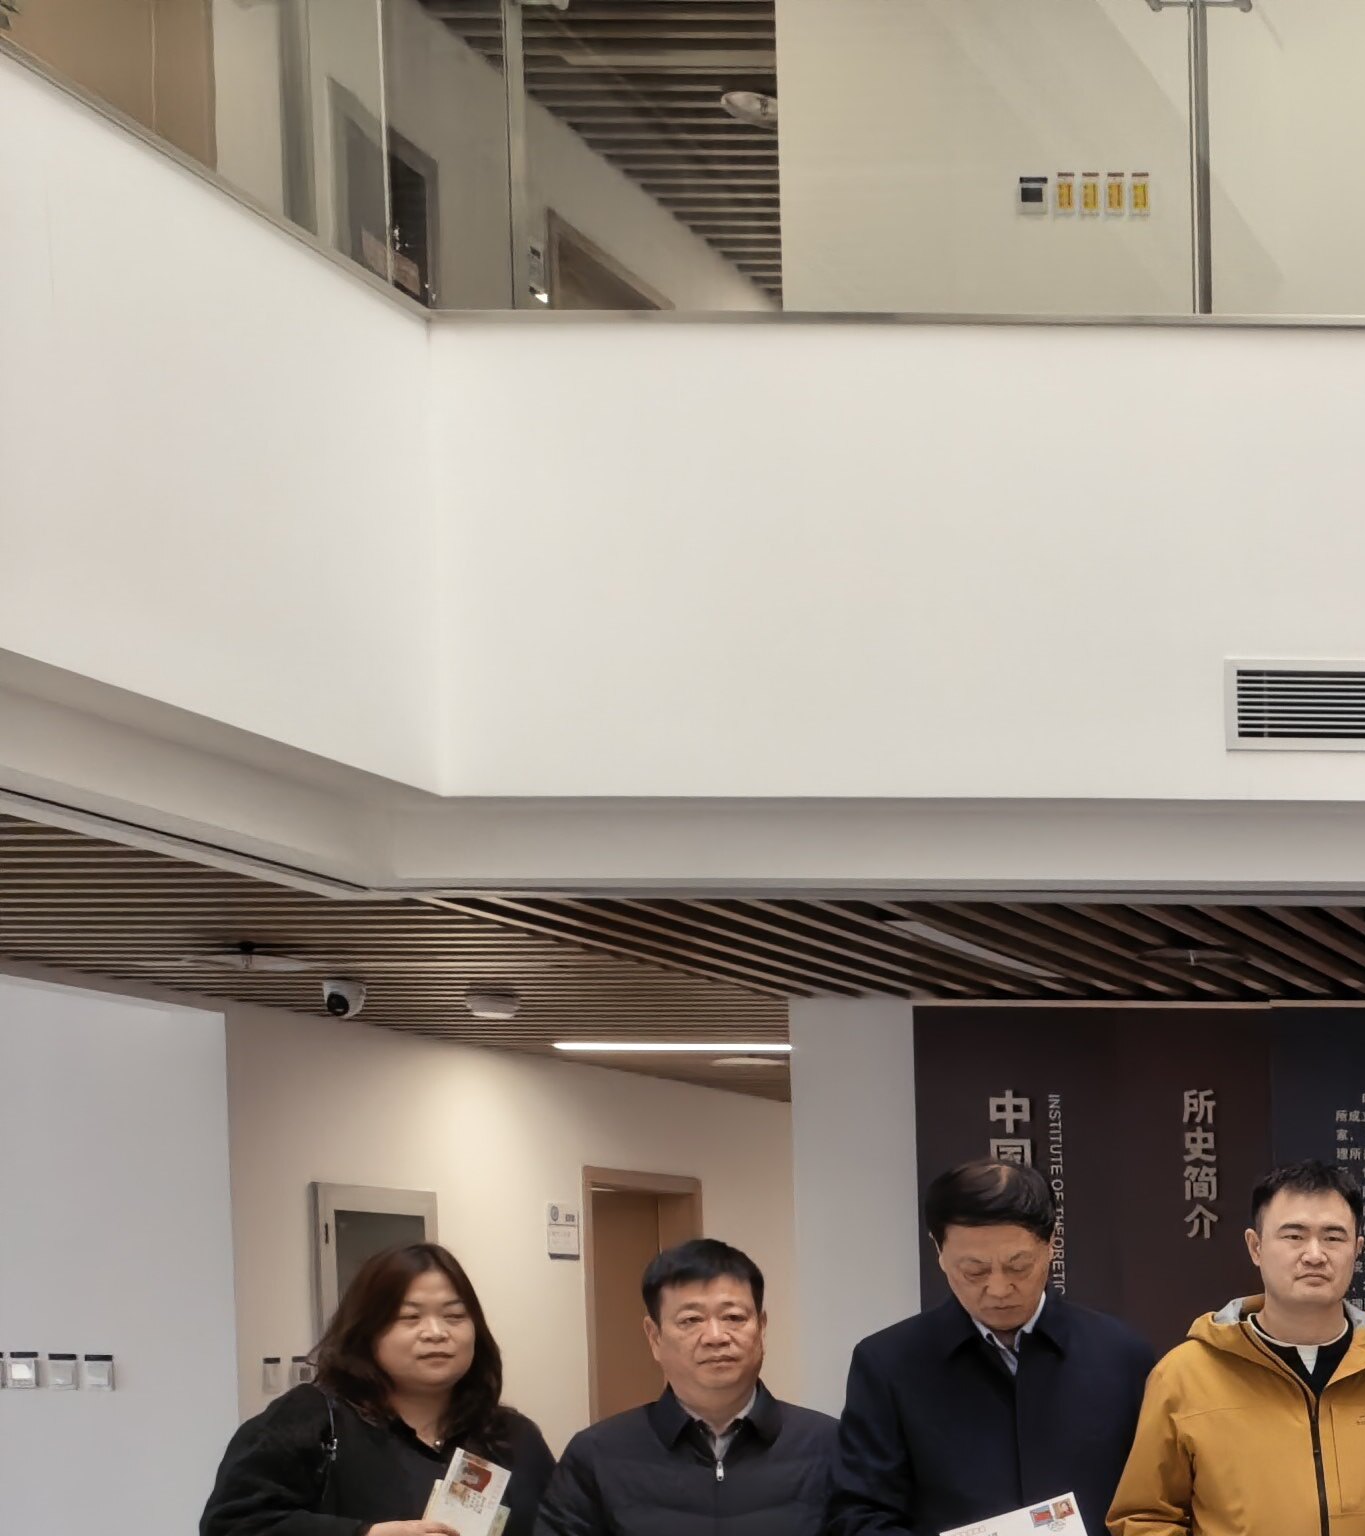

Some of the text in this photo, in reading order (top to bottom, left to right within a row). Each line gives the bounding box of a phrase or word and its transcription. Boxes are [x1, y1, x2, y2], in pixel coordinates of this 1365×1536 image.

[1048, 1094, 1064, 1176] INSTITUTE
[1183, 1090, 1218, 1239] 所史简介
